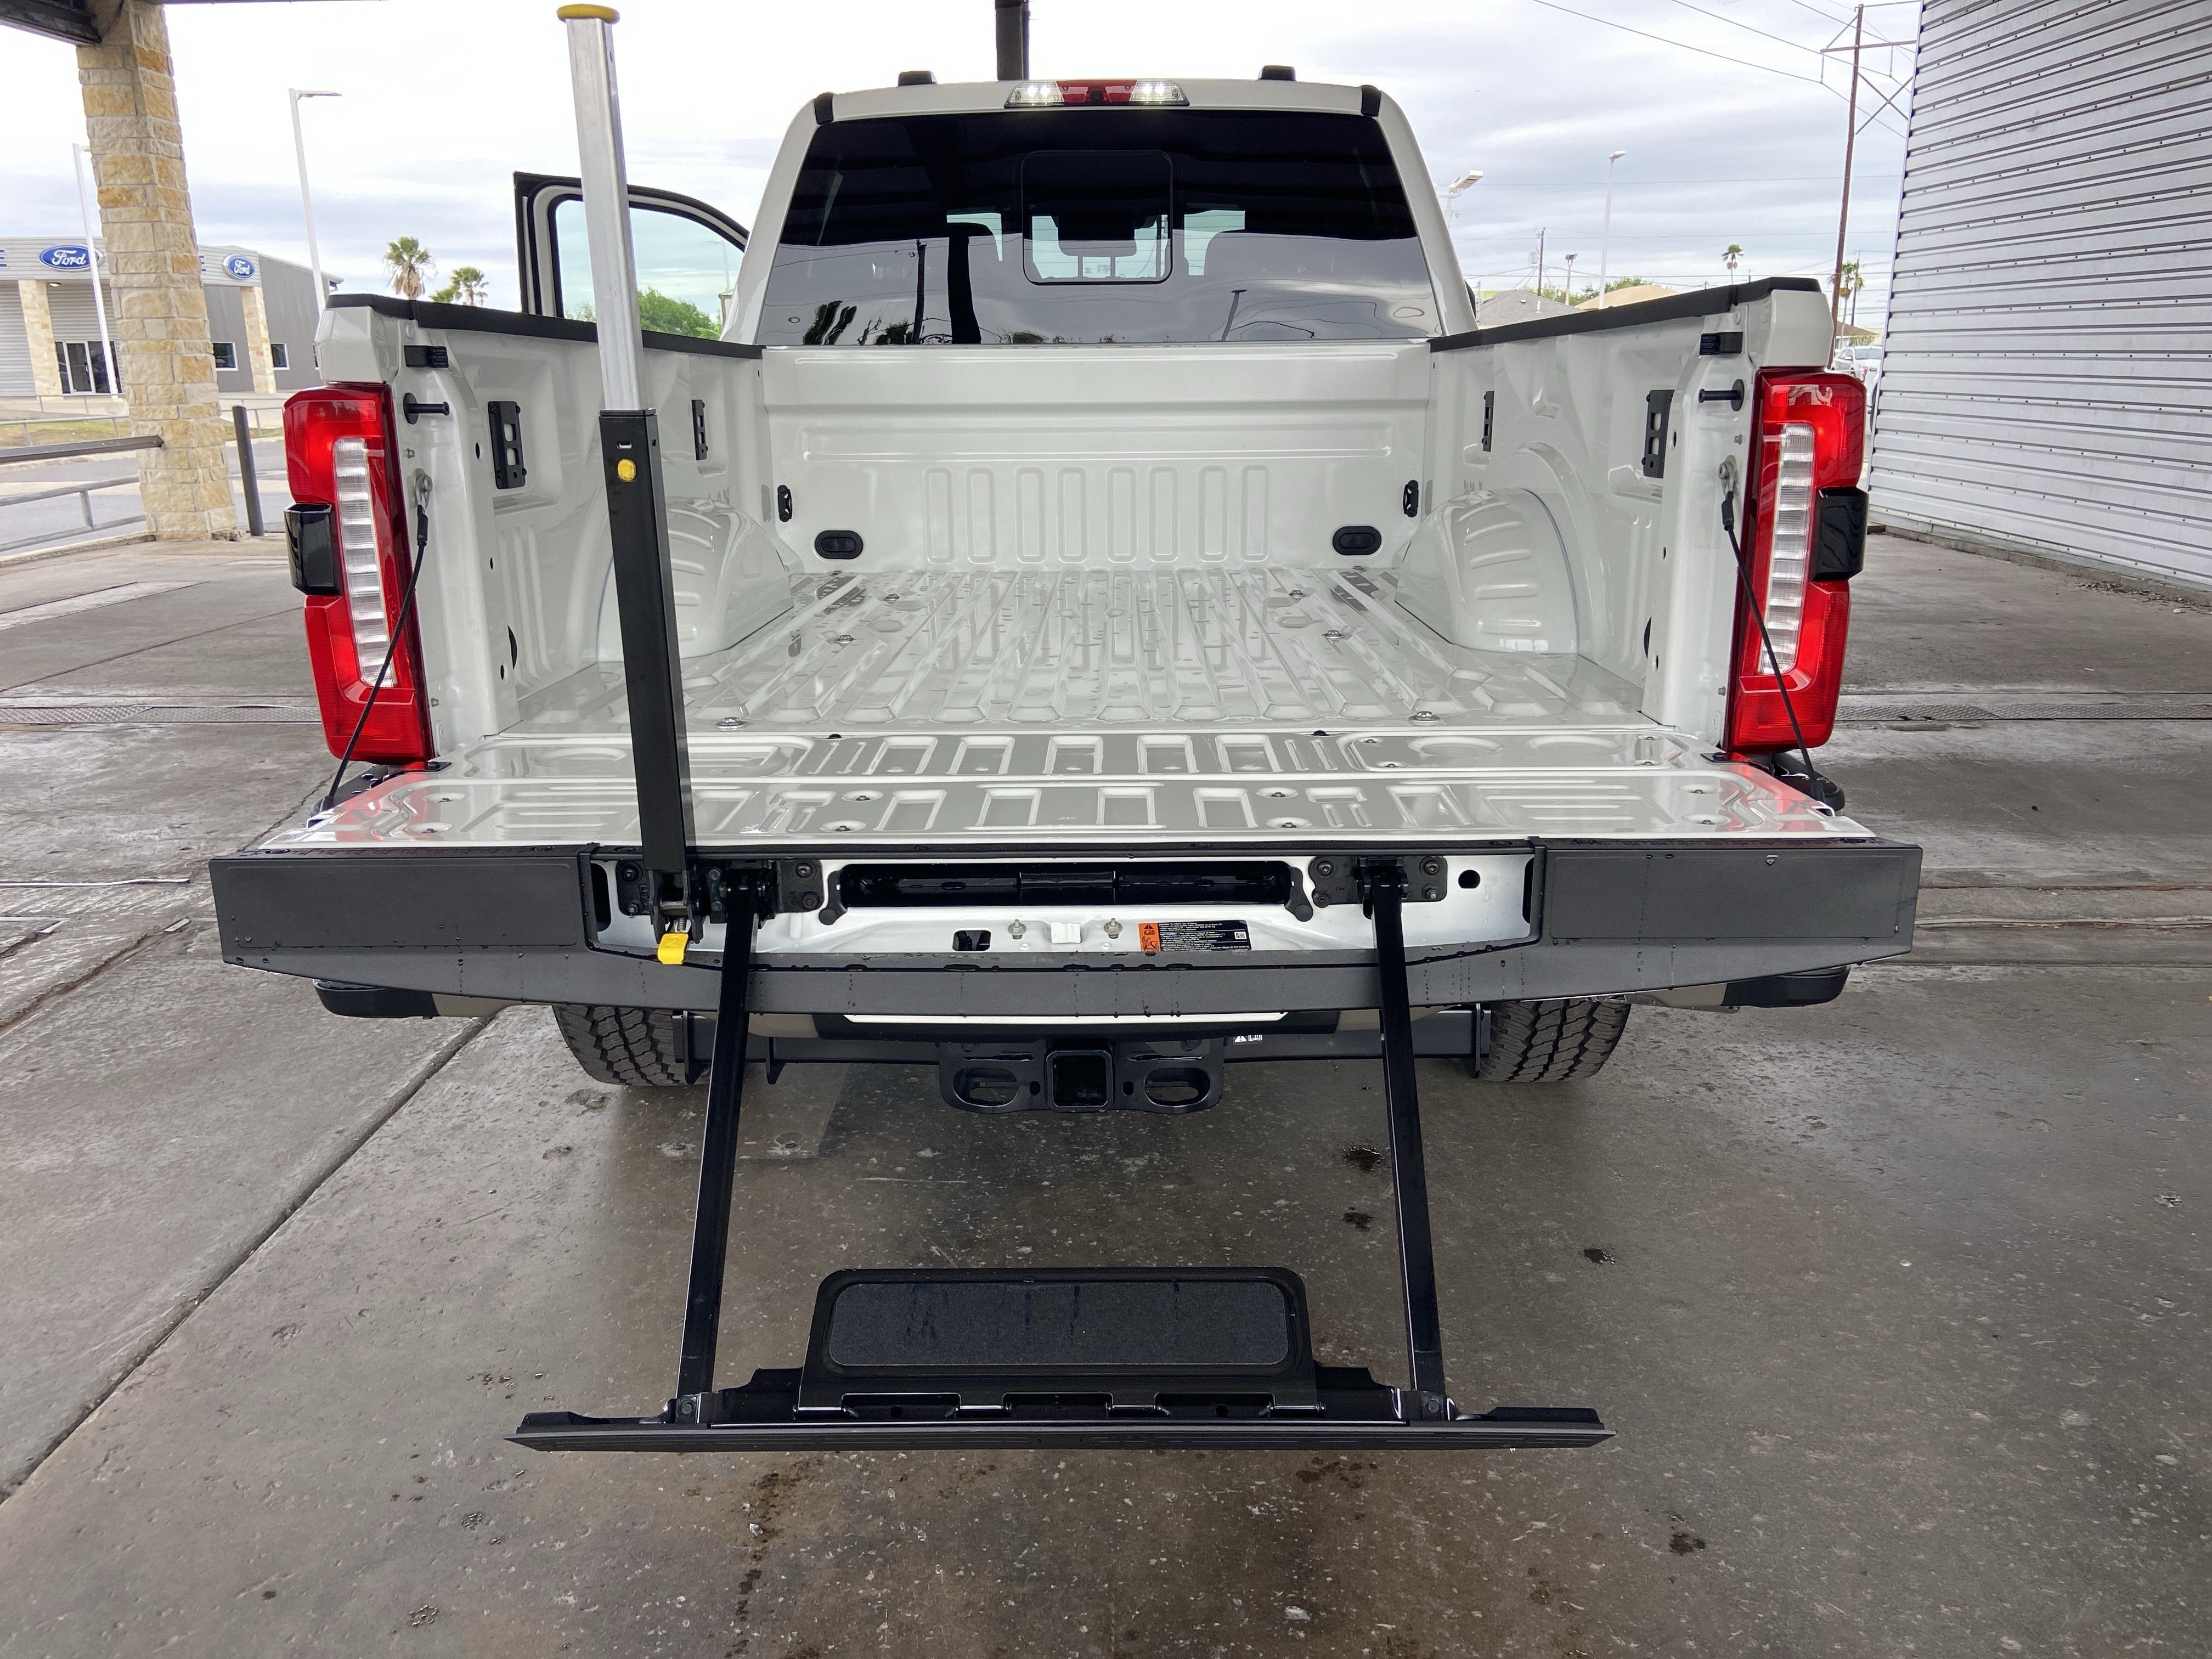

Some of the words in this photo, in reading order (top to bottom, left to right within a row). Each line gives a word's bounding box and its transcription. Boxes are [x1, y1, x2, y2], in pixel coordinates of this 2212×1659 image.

[52, 249, 87, 266] Ford
[234, 259, 251, 275] Ford
[665, 935, 680, 947] 2
